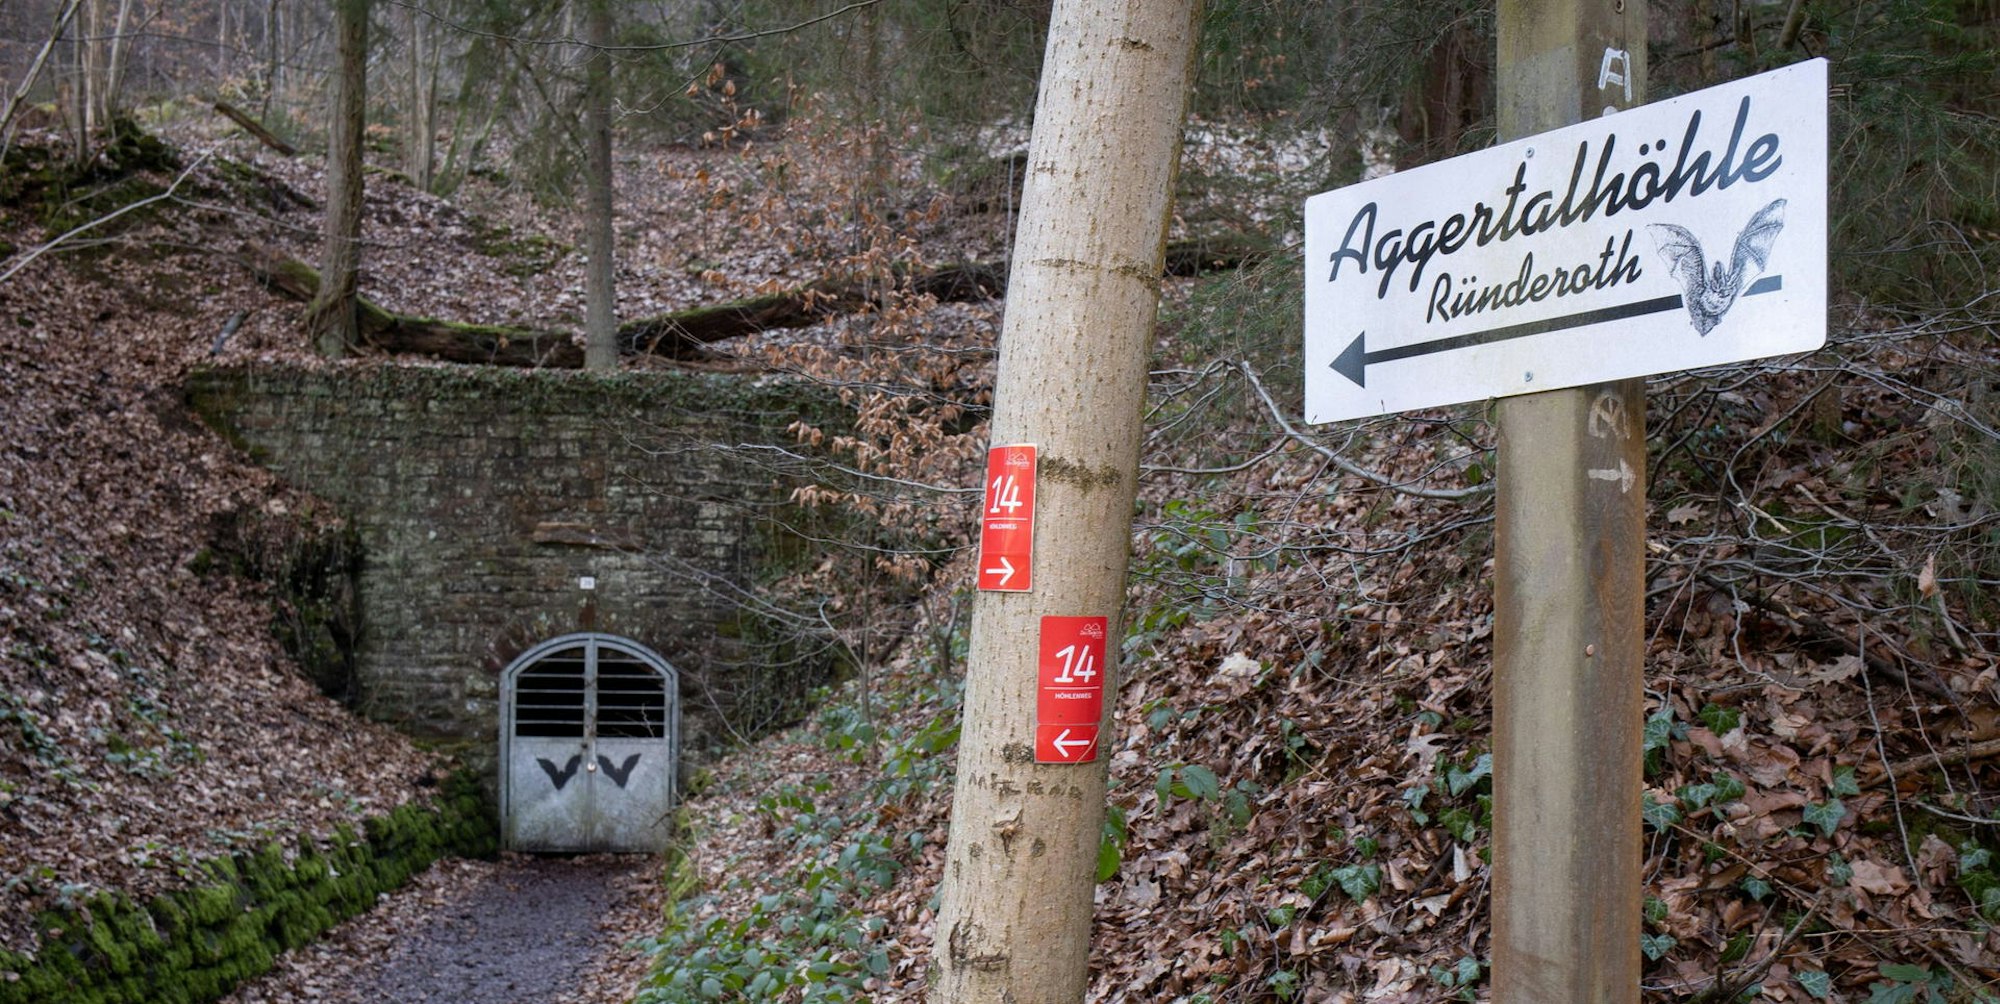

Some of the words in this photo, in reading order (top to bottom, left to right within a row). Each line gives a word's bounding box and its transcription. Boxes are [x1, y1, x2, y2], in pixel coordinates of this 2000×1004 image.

[1328, 95, 1783, 299] Aggertalhöhle
[1426, 229, 1643, 324] Ründeroth
[989, 475, 1023, 514] 14
[1053, 644, 1097, 683] 14
